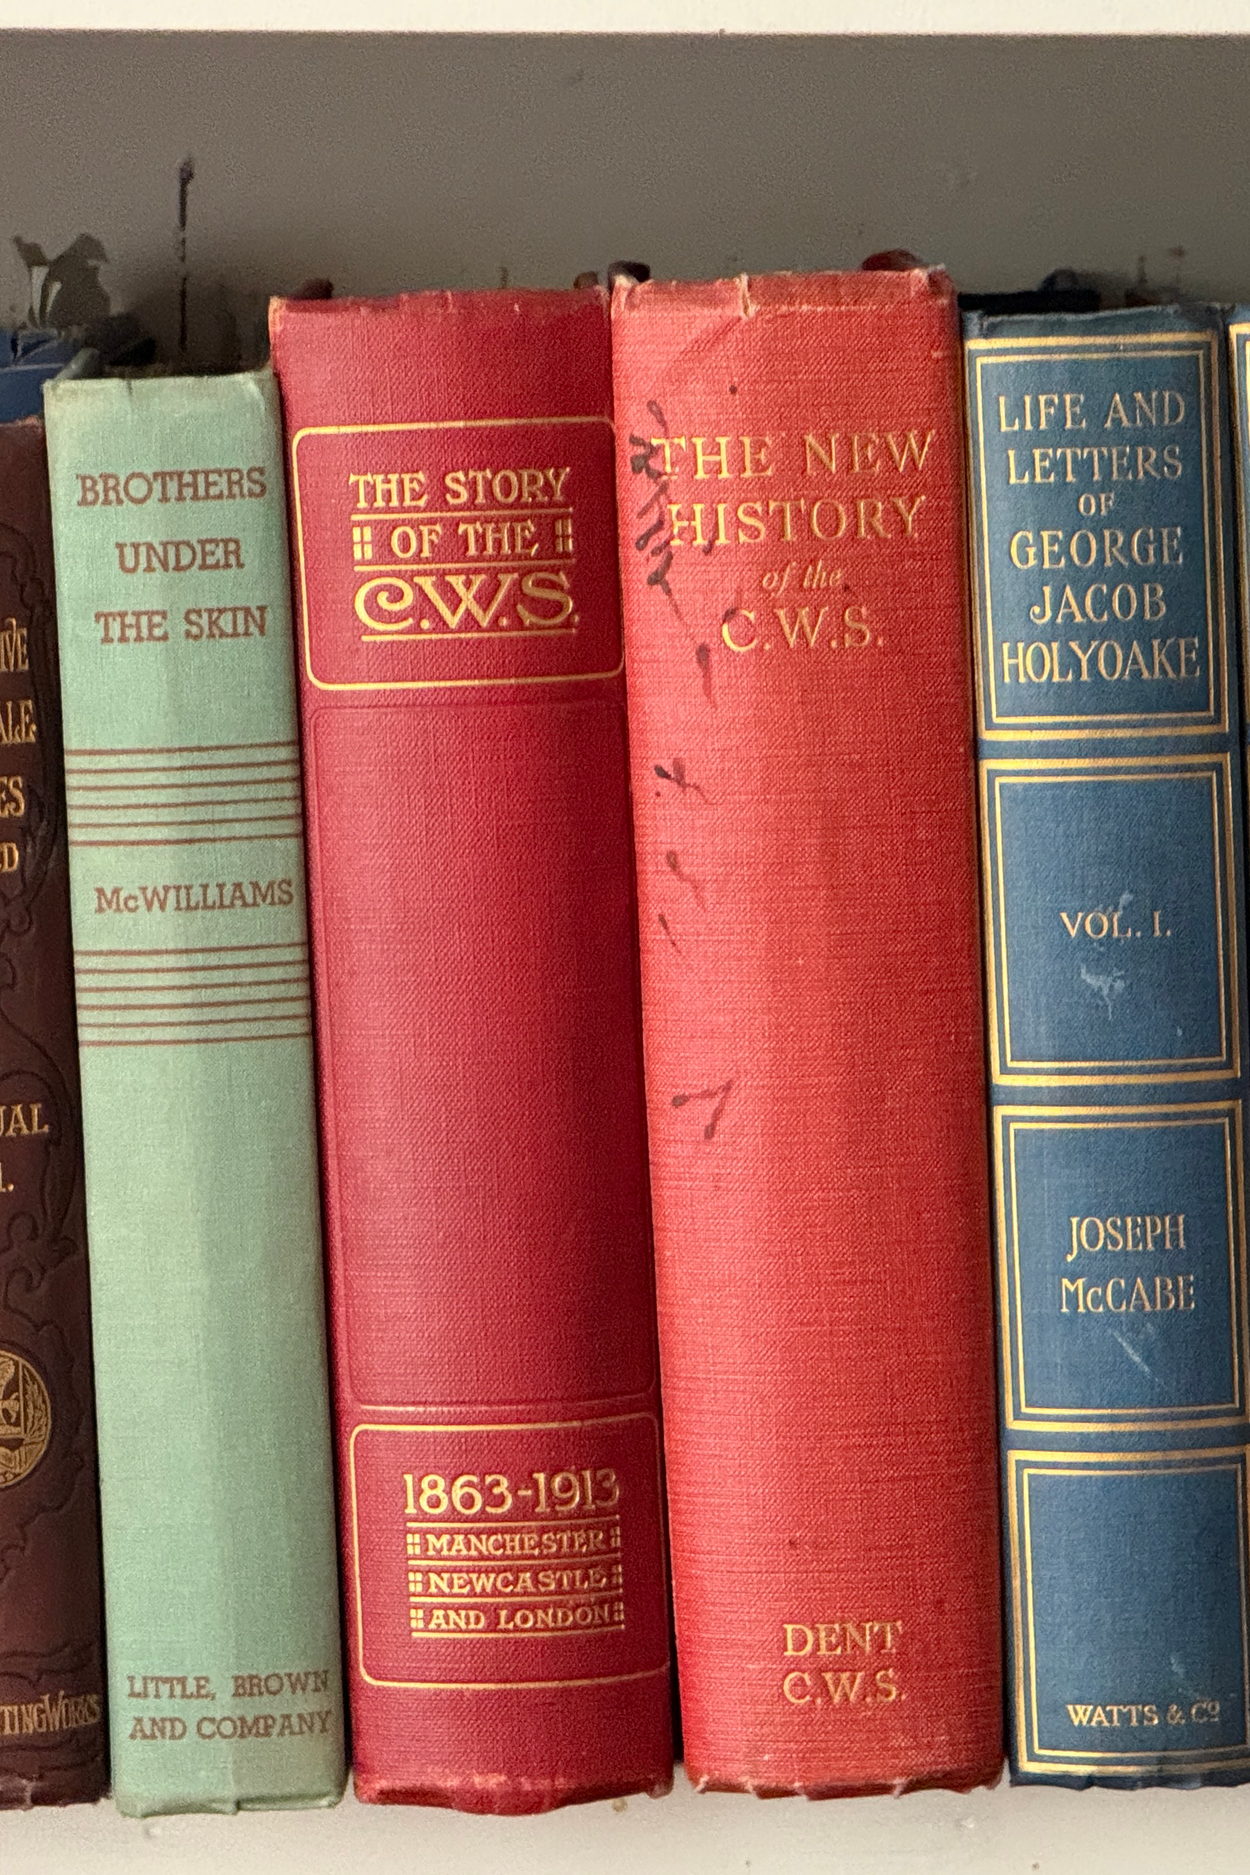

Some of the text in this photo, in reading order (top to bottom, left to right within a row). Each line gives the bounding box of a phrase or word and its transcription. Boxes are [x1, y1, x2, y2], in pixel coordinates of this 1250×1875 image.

[998, 390, 1186, 433] LIFE AND
[650, 429, 936, 480] THE NEW
[1007, 444, 1183, 485] LETTERS
[76, 467, 267, 507] BROTHERS
[348, 466, 571, 508] THE STORY
[1078, 492, 1115, 517] OF
[391, 518, 539, 558] OF THE
[667, 495, 926, 546] HISTORY
[115, 537, 245, 574] UNDER
[1010, 526, 1183, 570] GEORGE
[762, 560, 841, 597] of the
[354, 571, 579, 631] C.W.S.
[1029, 582, 1166, 625] JACOB
[94, 605, 268, 644] THE SKIN
[721, 605, 883, 653] C.W.S.
[1002, 636, 1200, 684] HOLYOAKE
[94, 878, 294, 914] McWILLIAMS
[1059, 909, 1172, 939] VOL. I.
[1066, 1214, 1187, 1262] JOSEPH
[1060, 1274, 1195, 1314] McCABE
[403, 1466, 620, 1515] 1863-1913
[426, 1530, 606, 1556] MANCHESTER
[427, 1568, 607, 1594] NEWCASTLE
[428, 1603, 610, 1630] AND LONDON
[782, 1620, 903, 1656] DENT
[127, 1669, 330, 1701] LITTLE, BROWN
[783, 1668, 907, 1704] C.W.S.
[128, 1710, 332, 1740] AND COMPANY
[1066, 1704, 1159, 1727] WATTS
[1167, 1703, 1185, 1725] &
